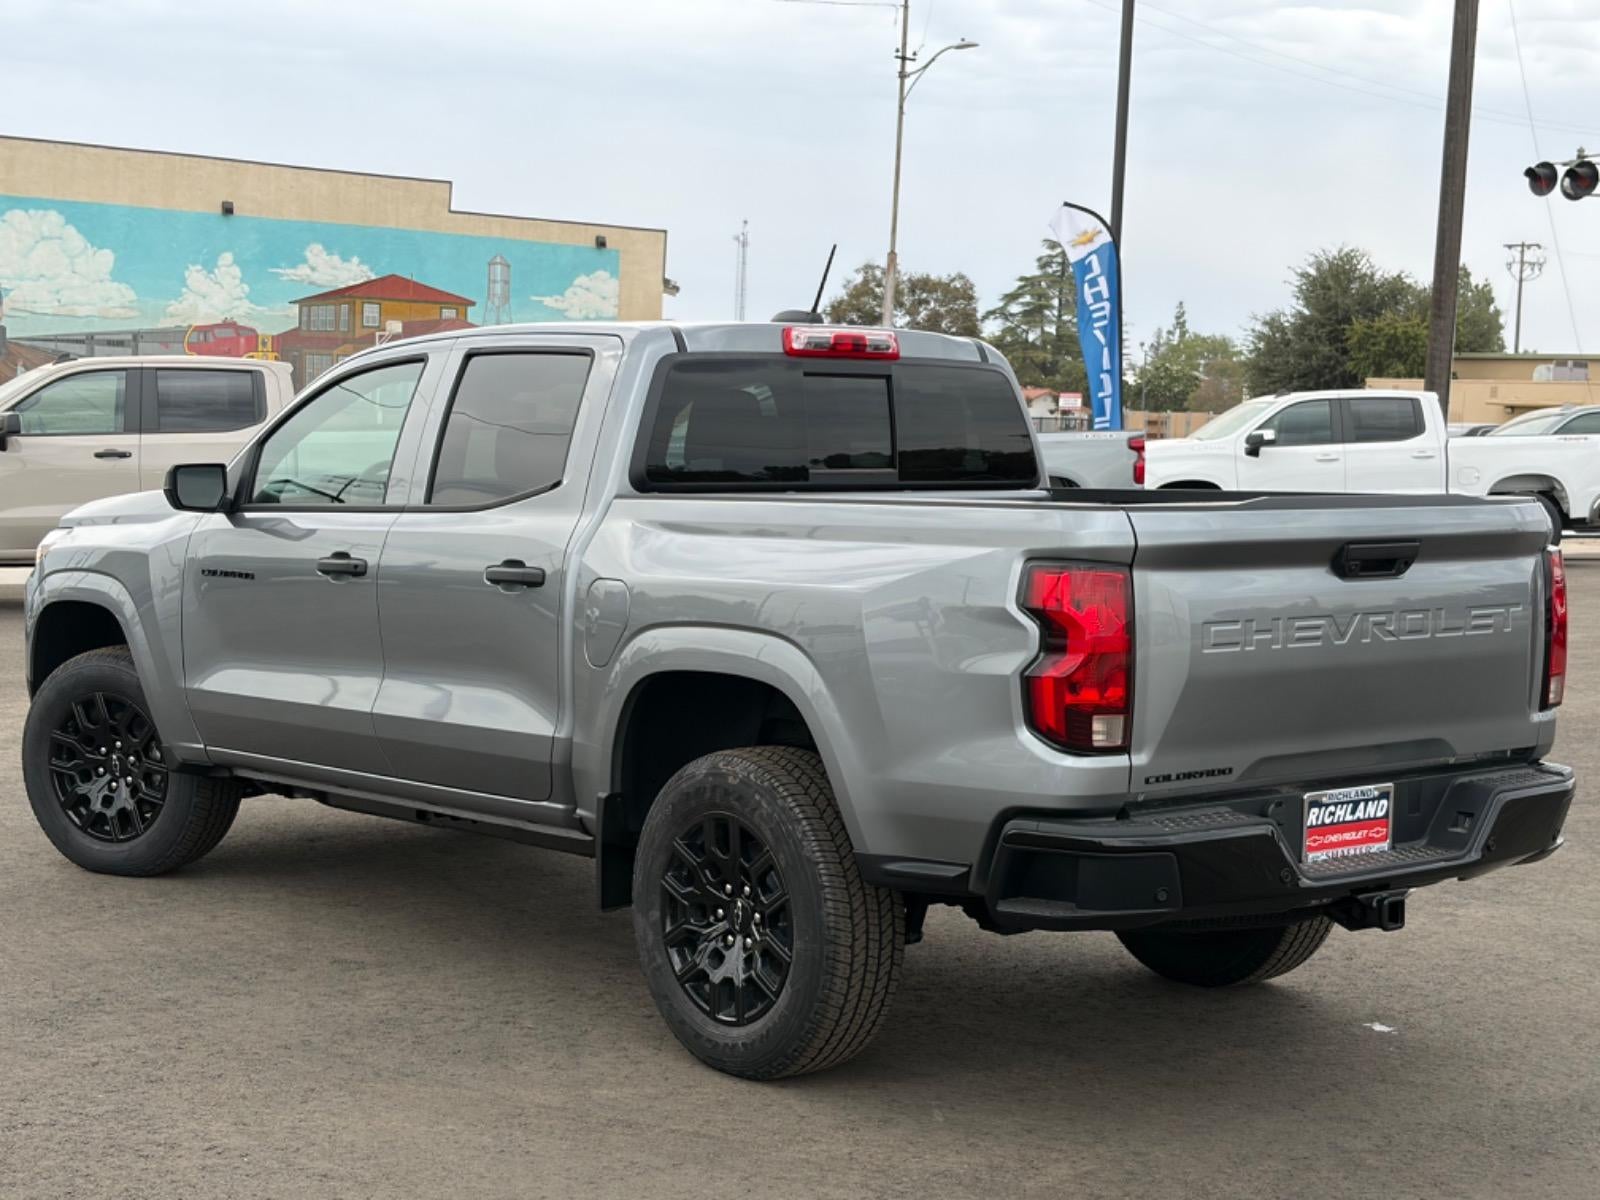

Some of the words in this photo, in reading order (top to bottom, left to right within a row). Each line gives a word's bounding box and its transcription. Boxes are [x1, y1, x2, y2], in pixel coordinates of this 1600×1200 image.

[1202, 603, 1523, 653] CHEVROLET
[1144, 767, 1233, 785] COLORADO
[1328, 788, 1375, 801] RICHLAND
[1307, 799, 1389, 826] RICHLAND
[1323, 830, 1369, 843] CHEVROLET
